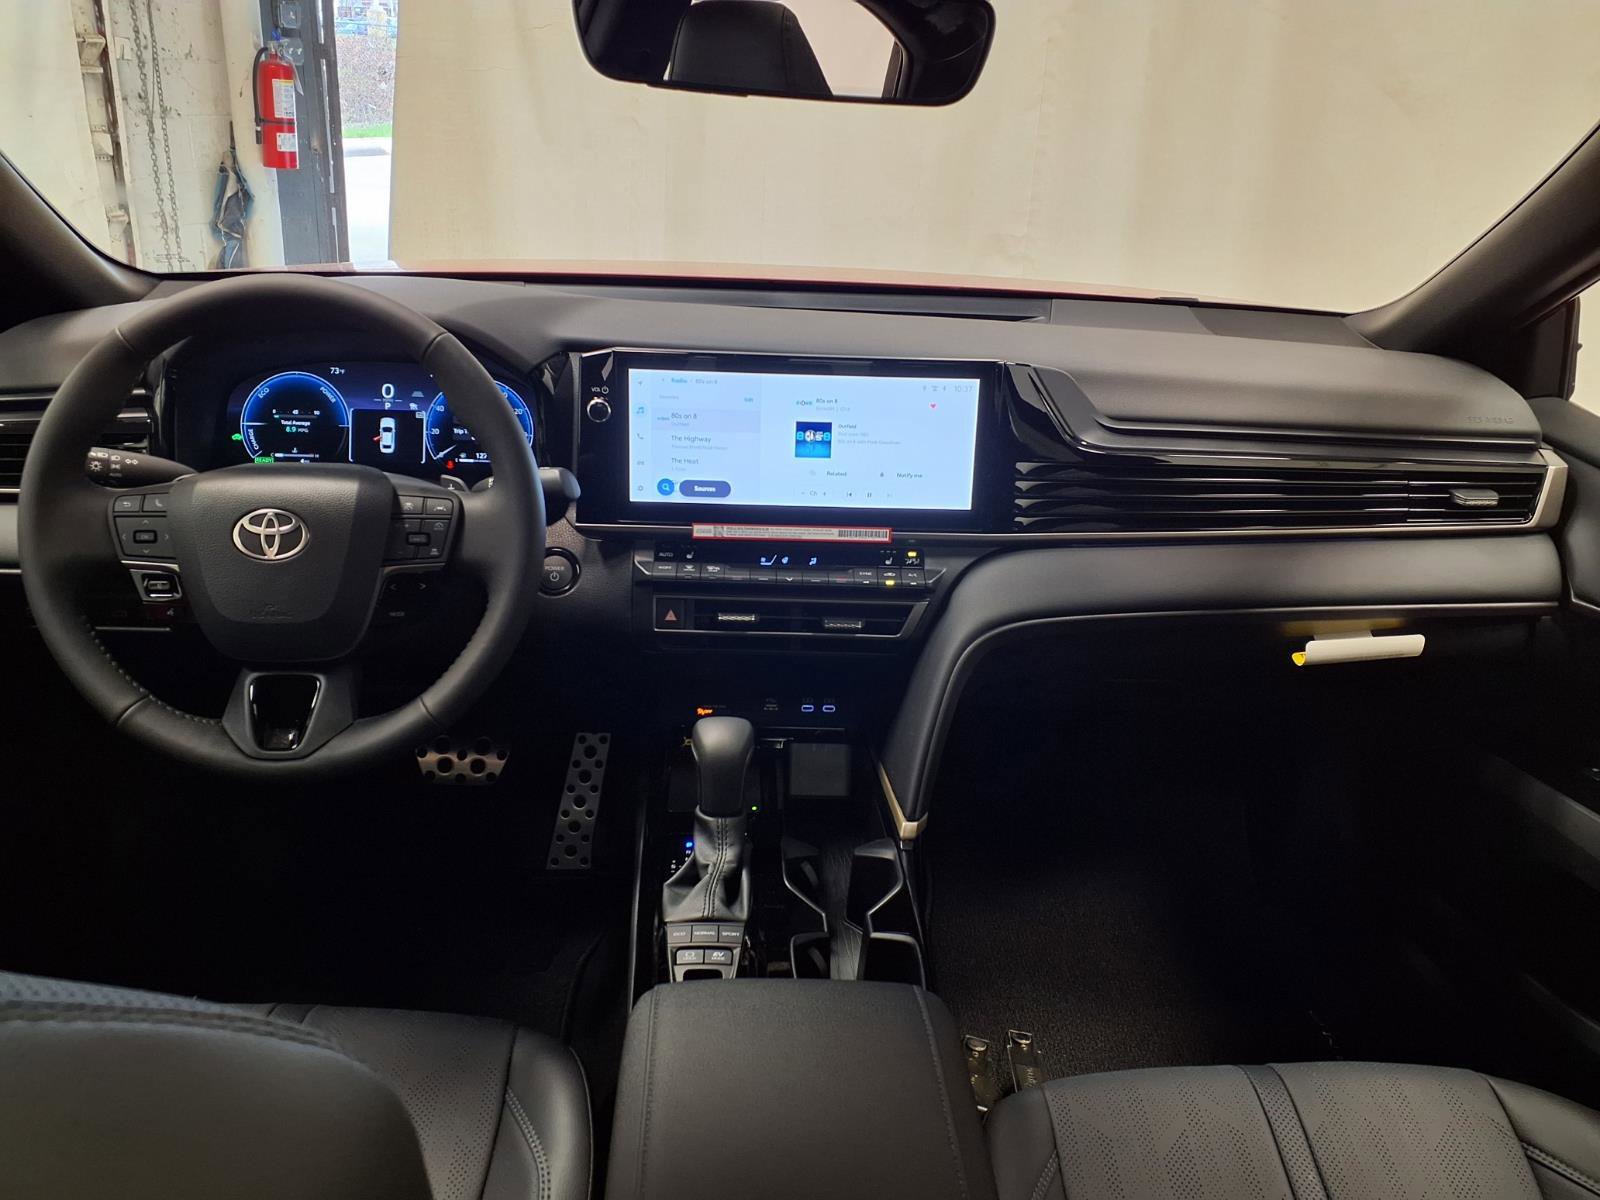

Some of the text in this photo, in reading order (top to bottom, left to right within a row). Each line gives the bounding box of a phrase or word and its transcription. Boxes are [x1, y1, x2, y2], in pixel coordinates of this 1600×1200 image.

[257, 387, 270, 399] ECO
[319, 386, 337, 404] POWER
[381, 383, 395, 399] 0
[684, 435, 712, 444] Highway
